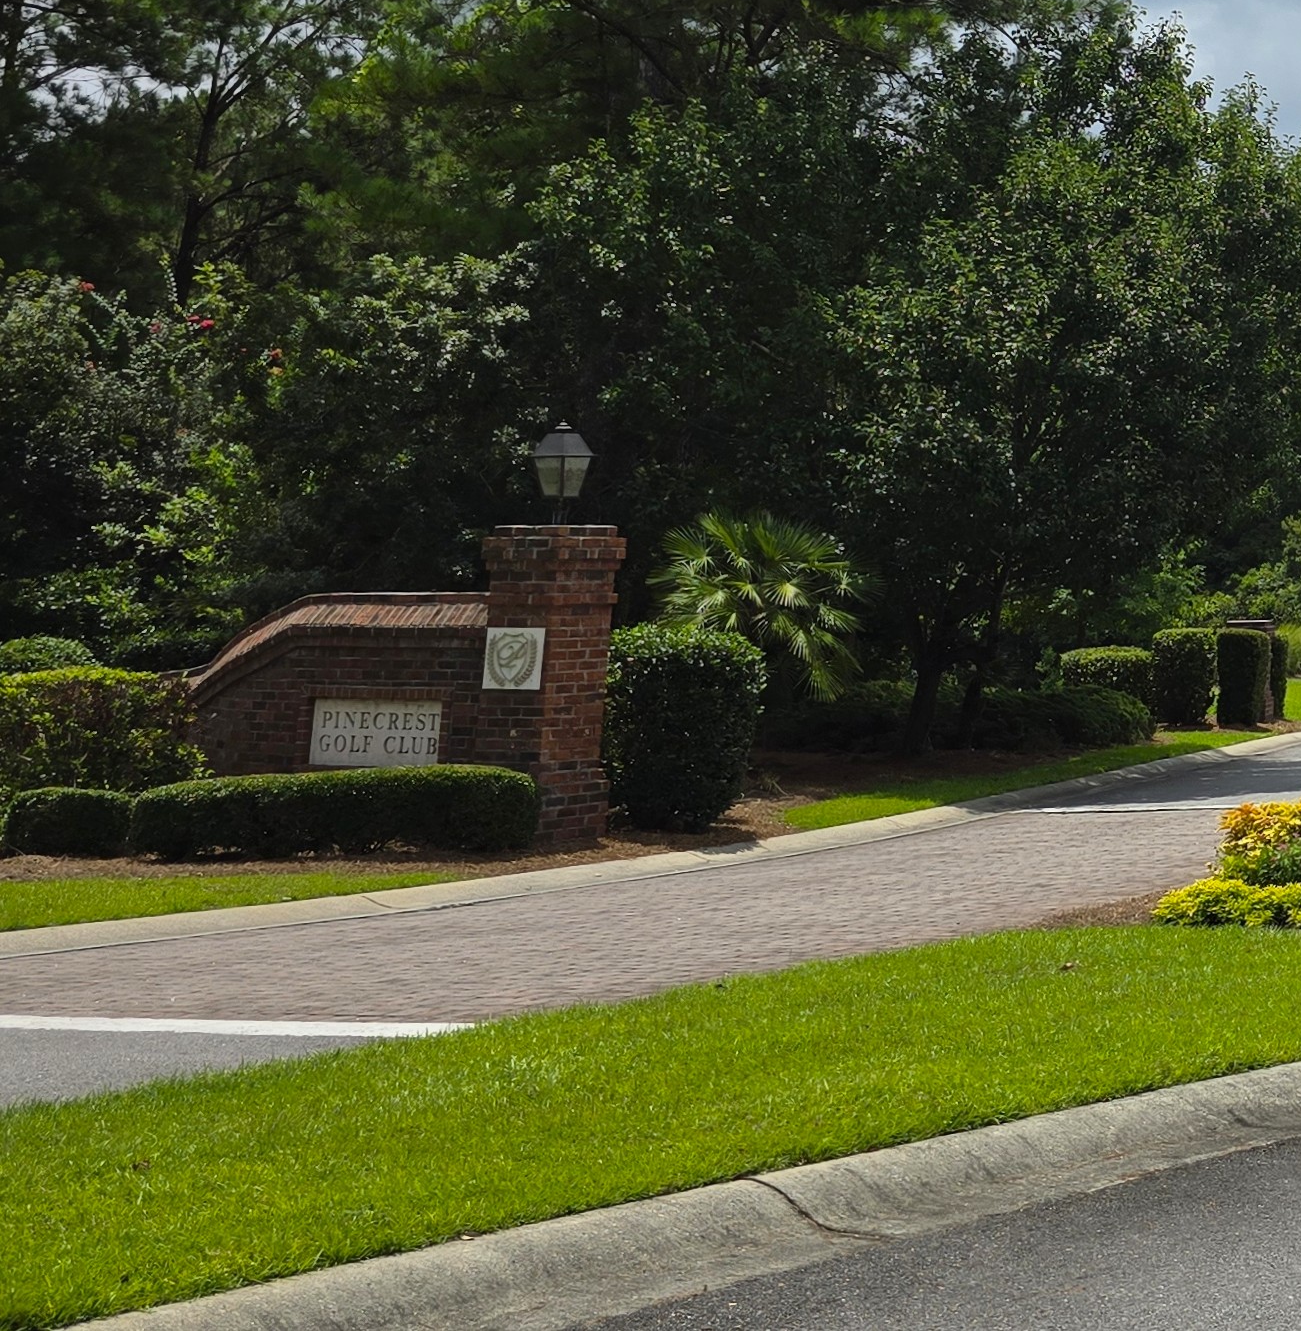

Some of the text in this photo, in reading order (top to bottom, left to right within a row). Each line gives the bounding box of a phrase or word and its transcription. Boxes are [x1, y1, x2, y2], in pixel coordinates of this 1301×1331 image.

[321, 711, 440, 731] PINECREST
[320, 734, 438, 755] GOLF CLUB
